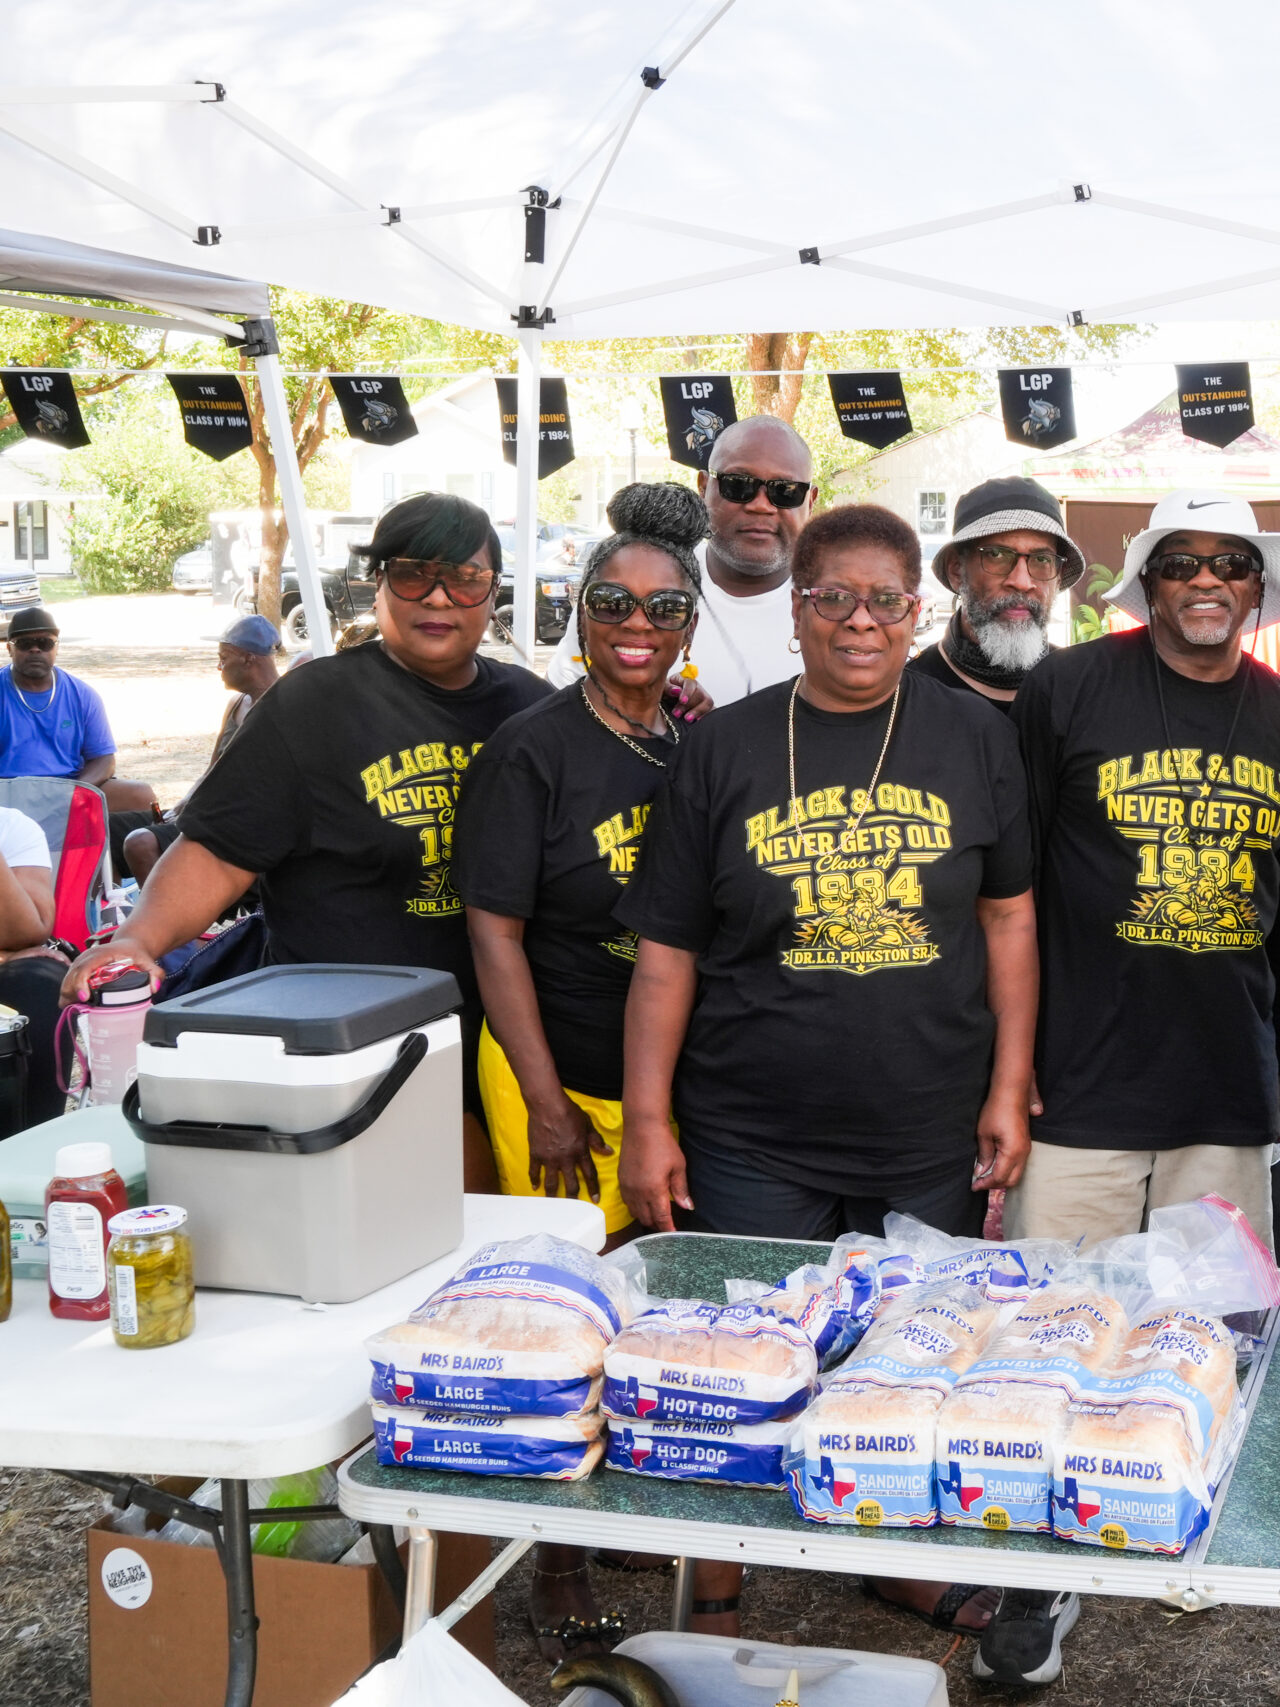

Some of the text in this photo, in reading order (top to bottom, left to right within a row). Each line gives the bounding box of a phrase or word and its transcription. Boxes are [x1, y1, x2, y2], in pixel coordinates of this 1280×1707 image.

[21, 376, 55, 392] LGP
[350, 380, 383, 394] LGP
[1019, 374, 1053, 391] LGP
[1204, 377, 1222, 386] THE
[199, 386, 218, 395] THE
[681, 382, 714, 399] LGP
[857, 387, 877, 396] THE
[1182, 390, 1247, 402] OUTSTANDING
[182, 400, 243, 411] OUTSTANDING
[838, 399, 902, 410] OUTSTANDING
[1182, 402, 1250, 418] CLASS OF 1984
[184, 415, 214, 425] CLASS
[214, 416, 225, 426] OF
[503, 413, 566, 423] OUTNDING
[841, 410, 907, 422] CLASS OF 1984
[547, 431, 570, 440] 1984
[360, 742, 453, 805] BLACK
[451, 745, 468, 770] &
[1097, 749, 1202, 802] BLACK
[1208, 753, 1231, 782] &
[377, 785, 451, 817] NEVER
[746, 782, 951, 852] BLACK & GOLD
[1106, 794, 1185, 826] NEVER
[1190, 800, 1251, 833] GETS
[757, 825, 951, 865] NEVER GETS OLD
[1164, 825, 1242, 852] Clss of
[815, 849, 897, 873] Class of
[1136, 844, 1256, 893] 1984
[792, 866, 923, 917] 1984
[1177, 929, 1240, 945] PINKSTON
[841, 947, 910, 963] PINKSTON
[479, 1265, 531, 1278] LARGE
[939, 1259, 963, 1275] MRS
[1016, 1303, 1111, 1327] MRS BAIRD'S
[421, 1353, 505, 1372] MRS BAIRD'S
[1159, 1342, 1203, 1366] TEXAS
[975, 1358, 1081, 1373] SANDWICH
[660, 1369, 747, 1393] MRS BAIRD'S
[1096, 1371, 1199, 1399] SANDWICH
[435, 1385, 485, 1401] LARGE
[663, 1396, 737, 1420] HOT DOG
[434, 1439, 483, 1454] LARGE
[819, 1434, 916, 1453] MRS BAIRD'S
[948, 1439, 1044, 1459] MRS BAIRD'S
[407, 1453, 509, 1467] 8 SEEDED HAMBURGER BUNS
[657, 1444, 728, 1464] HOT DOG
[661, 1460, 698, 1471] 8 CLASSIC
[1065, 1454, 1165, 1482] MRS BAIRD'S
[859, 1474, 928, 1490] SANDWICH
[986, 1479, 1049, 1497] SANDWIC
[1103, 1499, 1176, 1518] SANDWICH
[106, 1564, 144, 1582] LOVE THY
[108, 1571, 147, 1589] NEIGHBOR
